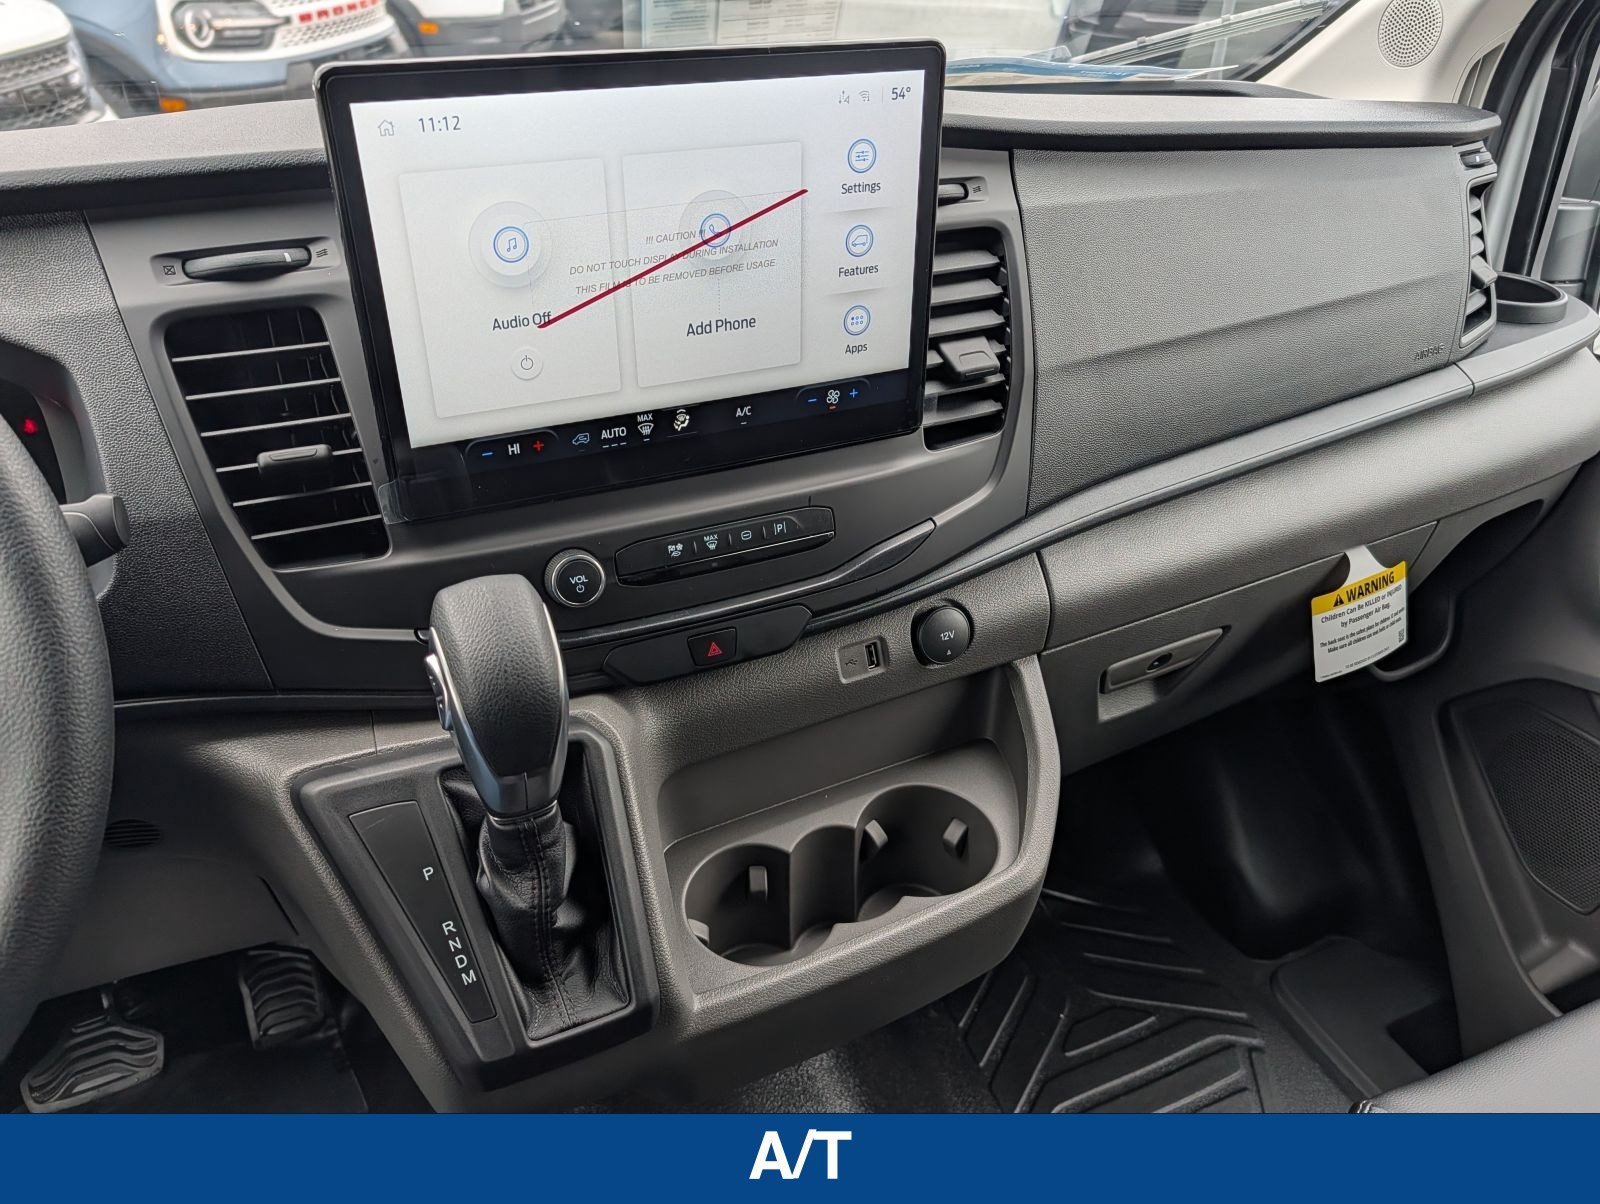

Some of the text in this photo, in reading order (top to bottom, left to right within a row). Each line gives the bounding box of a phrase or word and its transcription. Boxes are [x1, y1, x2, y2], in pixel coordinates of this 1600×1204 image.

[891, 86, 912, 101] 54°
[418, 115, 462, 133] 11:12
[841, 180, 881, 195] Settings
[656, 230, 696, 244] CAUTION
[570, 265, 584, 275] DO
[586, 262, 606, 273] NOT
[609, 258, 641, 270] TOUCH
[683, 246, 717, 260] DURING
[720, 239, 778, 255] INSTALLATION
[576, 285, 597, 294] THIS
[648, 275, 660, 285] BE
[662, 268, 707, 283] REMOVED
[709, 263, 744, 276] BEFORE
[746, 259, 776, 270] USAGE
[838, 263, 879, 278] Features
[492, 311, 552, 331] Audio Off
[686, 316, 756, 337] Add Phone
[844, 342, 868, 354] Apps
[637, 413, 653, 423] MAX
[736, 406, 752, 418] A/C
[601, 426, 627, 440] AUTO
[507, 443, 521, 456] HI
[569, 574, 589, 584] VOL
[1346, 571, 1395, 602] WARNING
[1321, 611, 1345, 623] Children
[1346, 606, 1356, 614] Can
[1365, 596, 1380, 608] KILLED
[1340, 620, 1348, 628] by
[1348, 610, 1374, 624] Passenger
[940, 630, 955, 640] 12V
[422, 866, 434, 881] P
[442, 920, 456, 936] R
[448, 936, 462, 952] N
[454, 954, 468, 968] D
[462, 969, 477, 986] M
